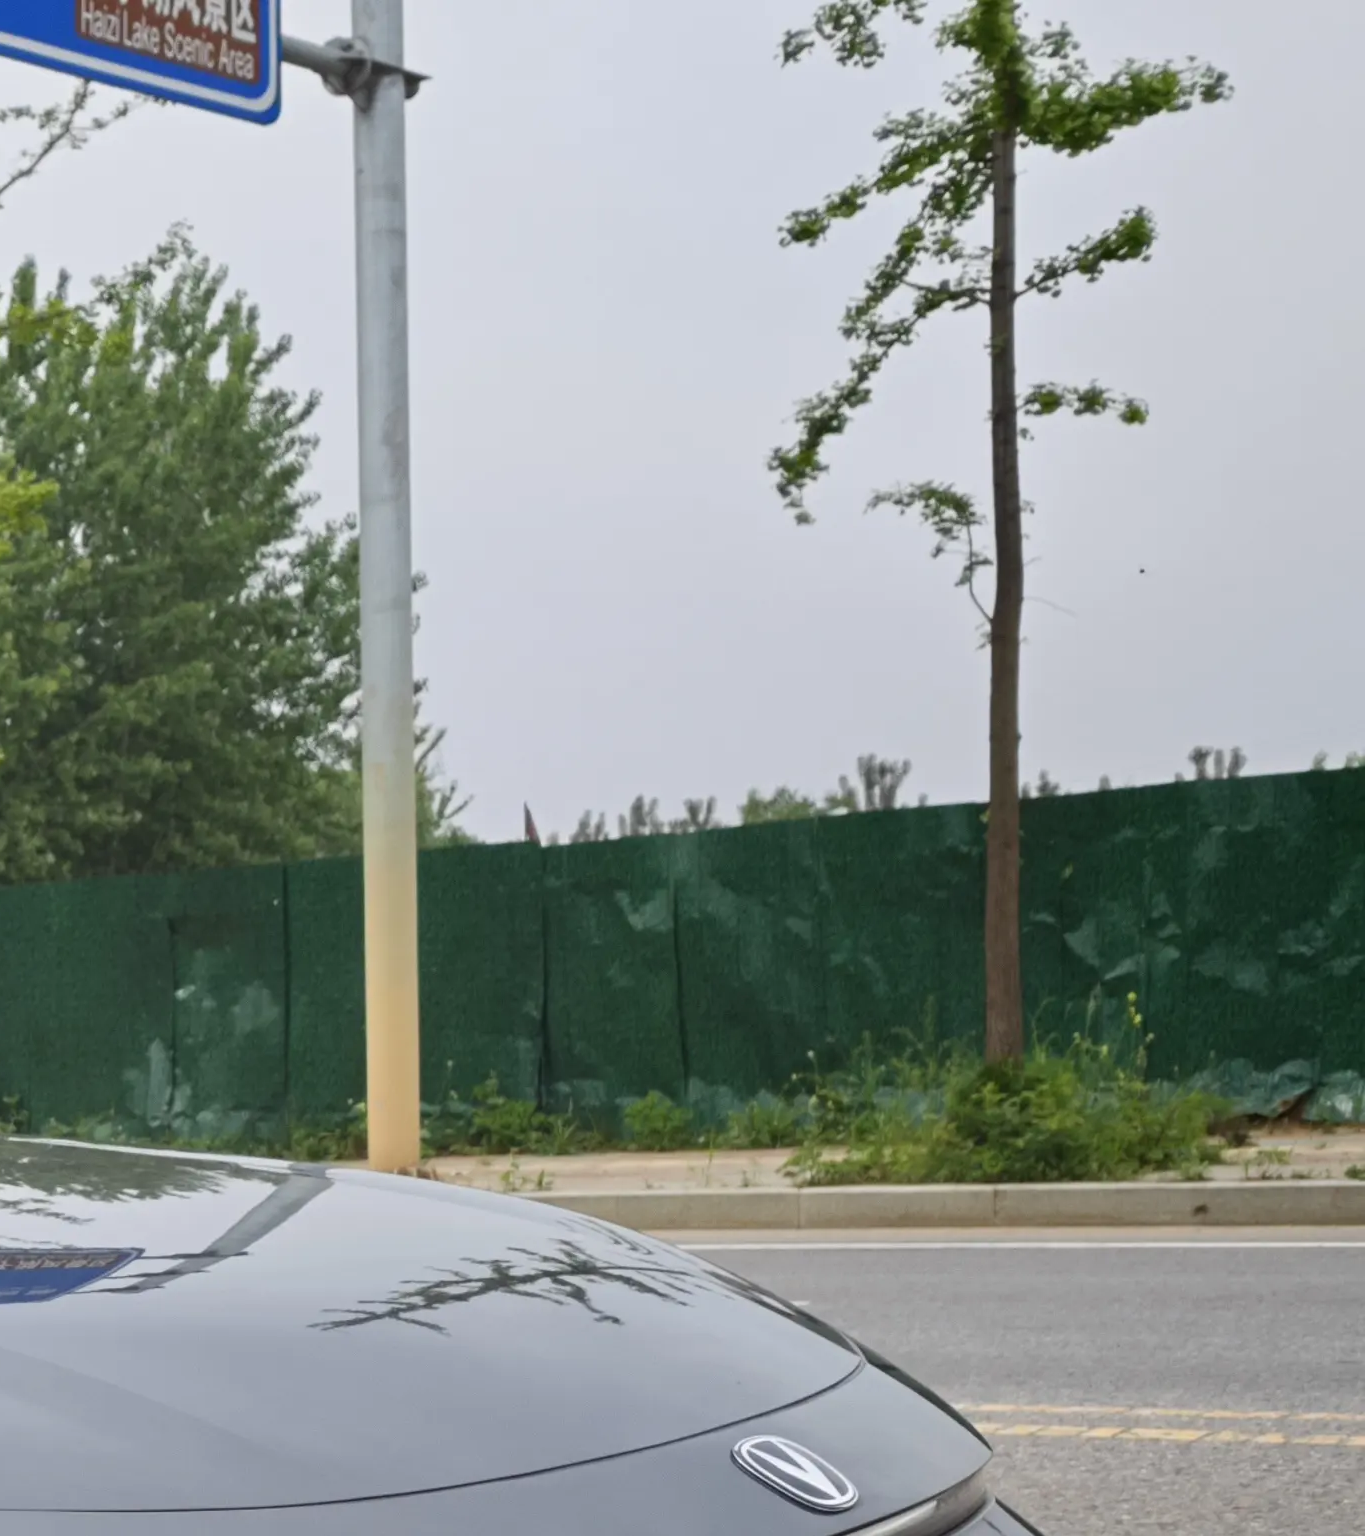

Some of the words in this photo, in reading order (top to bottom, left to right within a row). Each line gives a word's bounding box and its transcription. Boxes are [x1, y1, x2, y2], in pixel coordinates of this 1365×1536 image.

[80, 0, 119, 42] Haizi
[123, 9, 160, 53] Lake
[164, 21, 215, 68] Scenic
[219, 39, 255, 80] Area
